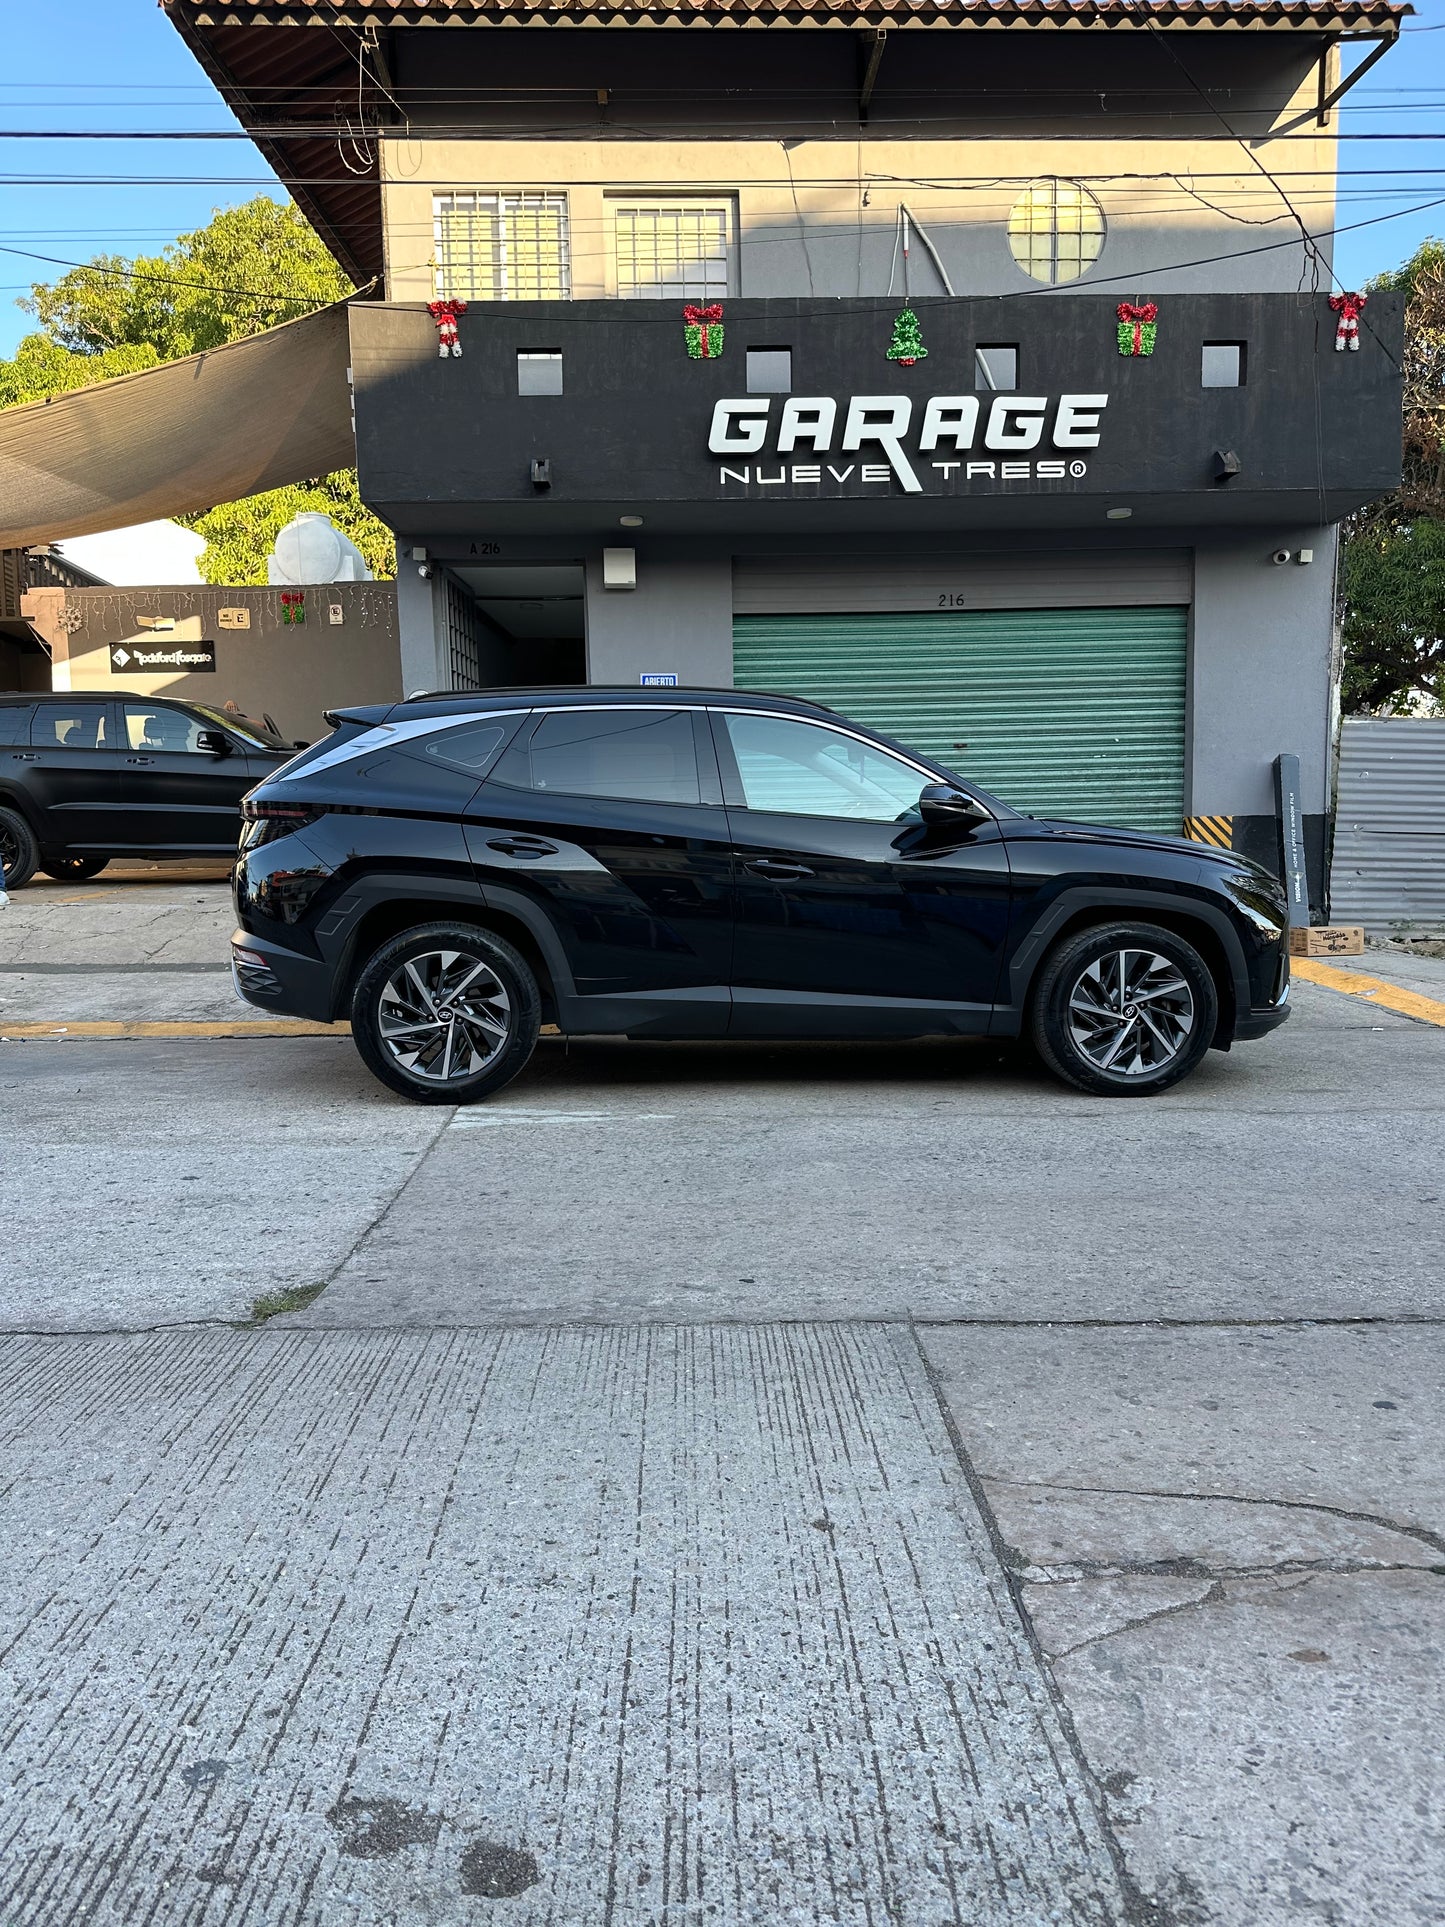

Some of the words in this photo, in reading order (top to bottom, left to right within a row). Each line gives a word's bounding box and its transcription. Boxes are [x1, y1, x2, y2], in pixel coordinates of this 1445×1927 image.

[708, 393, 1109, 492] GARAGE
[720, 464, 891, 484] NUEVE
[469, 542, 478, 555] A
[481, 542, 501, 555] 216
[938, 593, 965, 606] 216
[644, 676, 674, 686] ABIERTO
